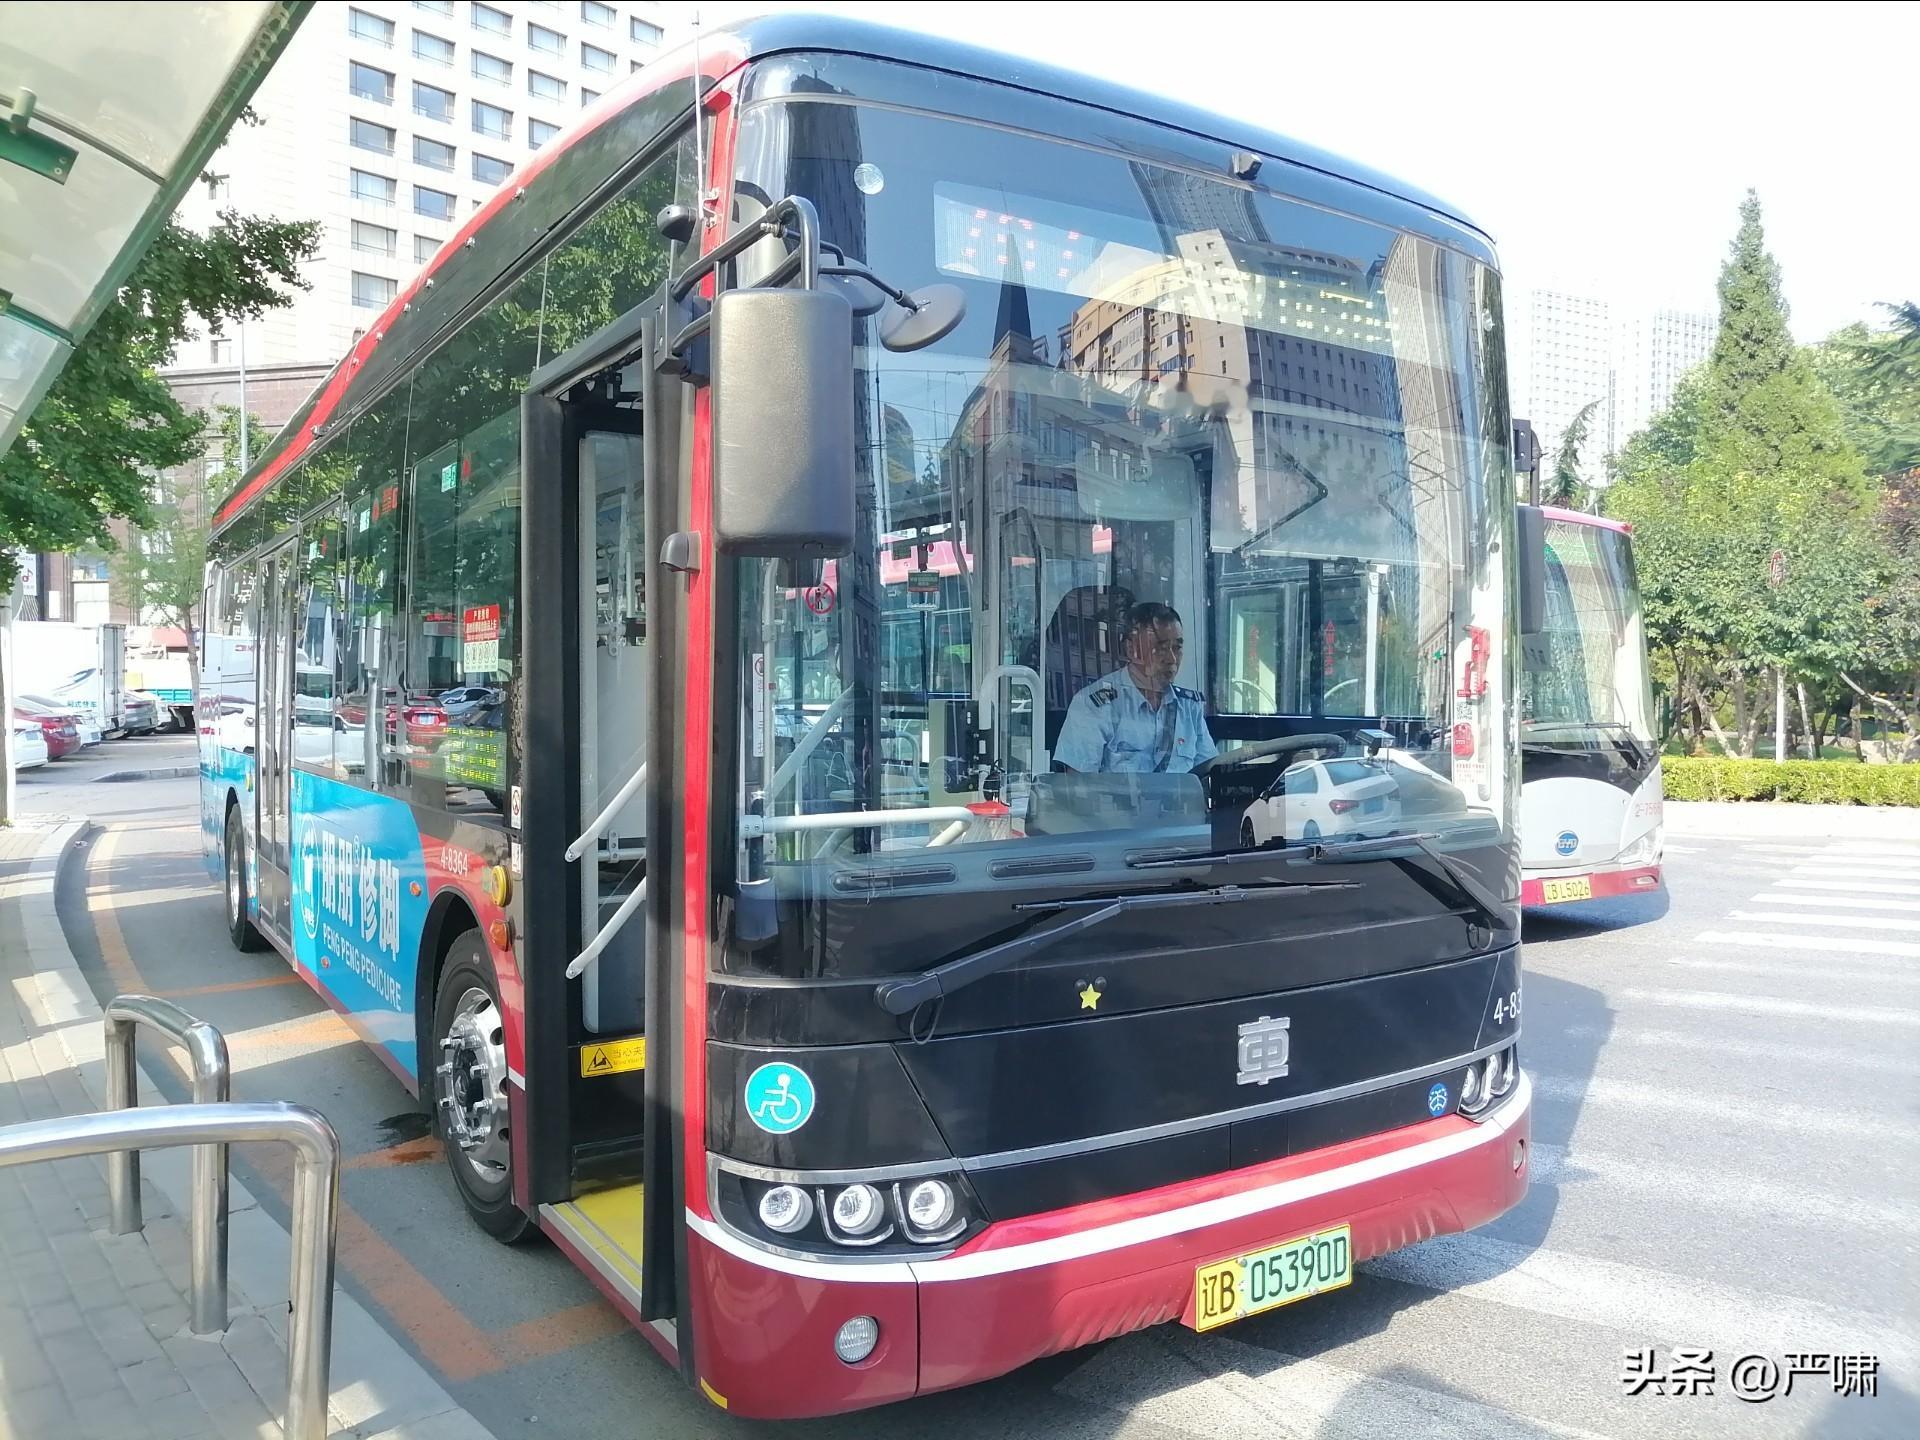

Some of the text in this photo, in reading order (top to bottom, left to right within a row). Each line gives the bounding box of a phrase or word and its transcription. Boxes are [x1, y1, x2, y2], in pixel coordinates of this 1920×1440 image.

[440, 846, 468, 878] 4-8364
[322, 922, 402, 1012] PENG PENG PEDICURE
